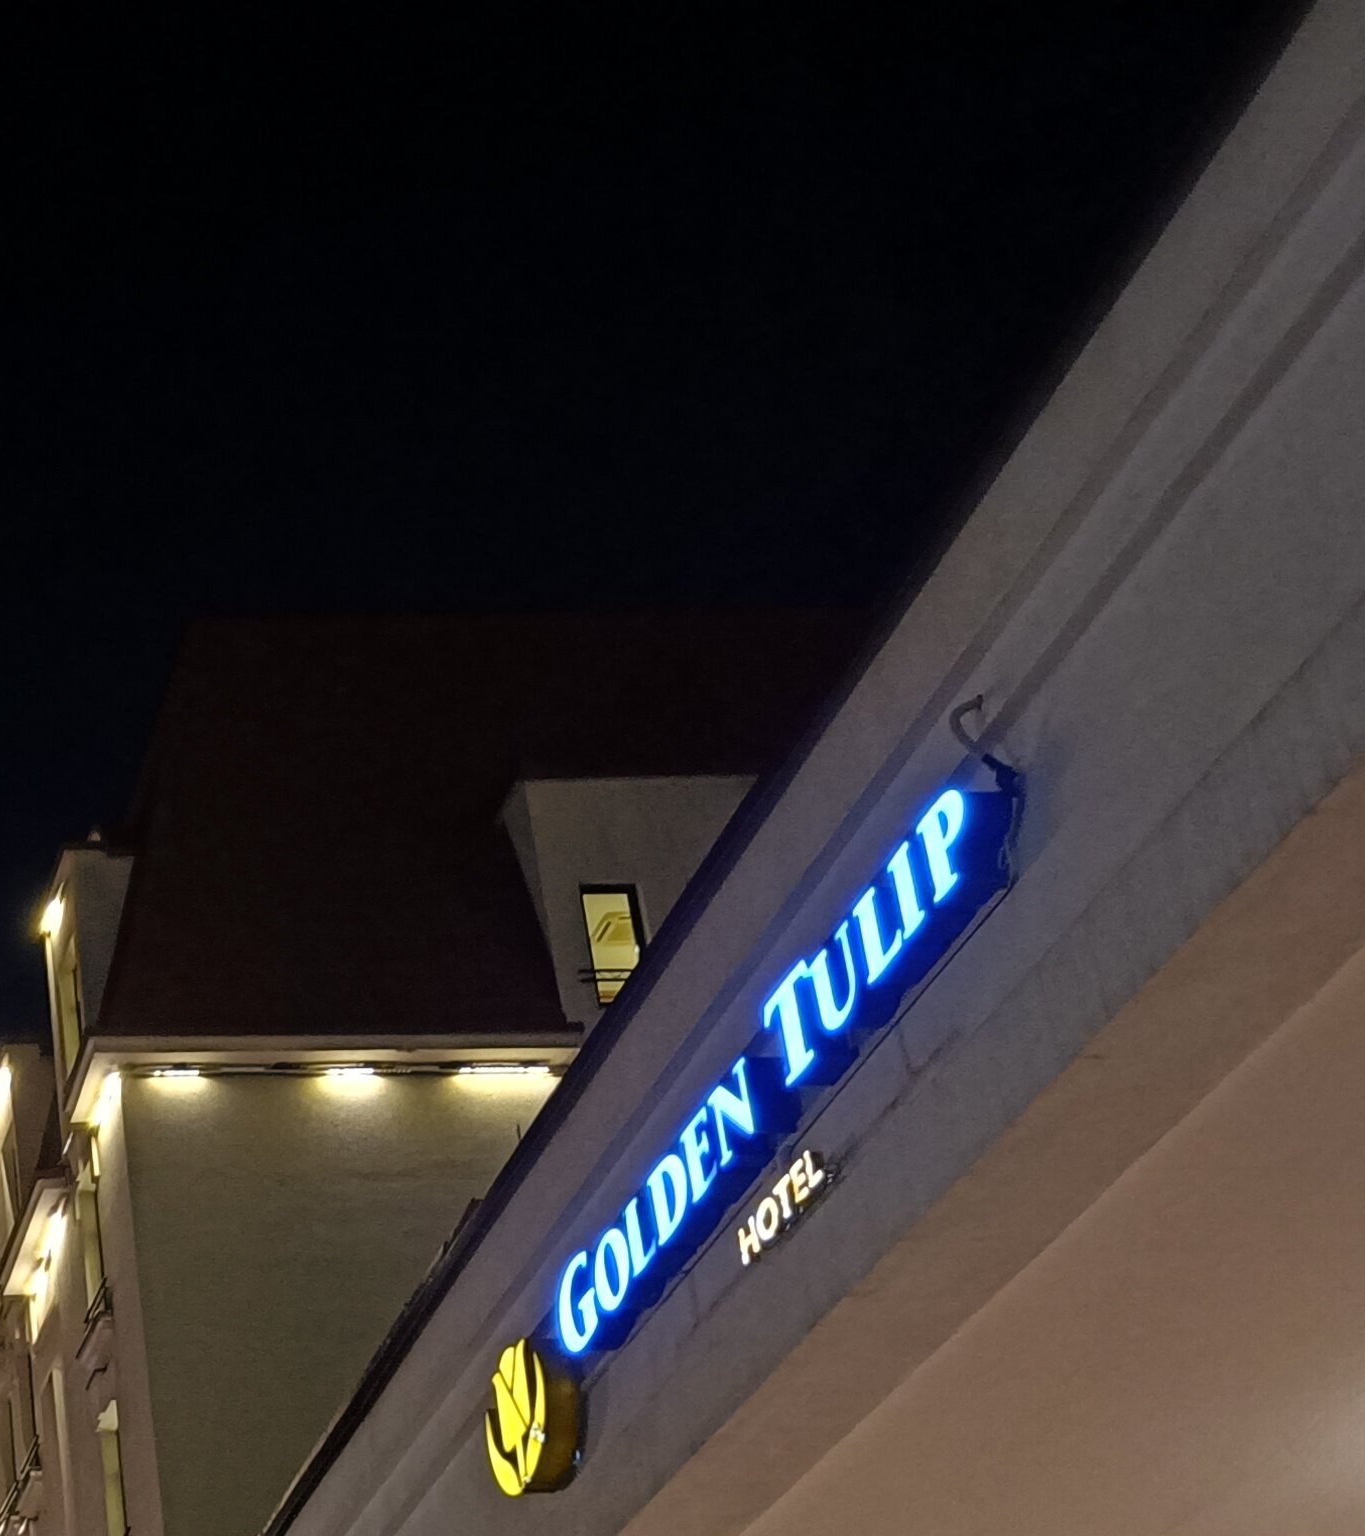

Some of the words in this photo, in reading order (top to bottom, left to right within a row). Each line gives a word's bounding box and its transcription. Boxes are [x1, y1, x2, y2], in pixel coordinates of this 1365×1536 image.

[555, 1056, 759, 1354] GOLDEN
[763, 787, 967, 1087] TULIP
[737, 1150, 827, 1265] HOTEL
